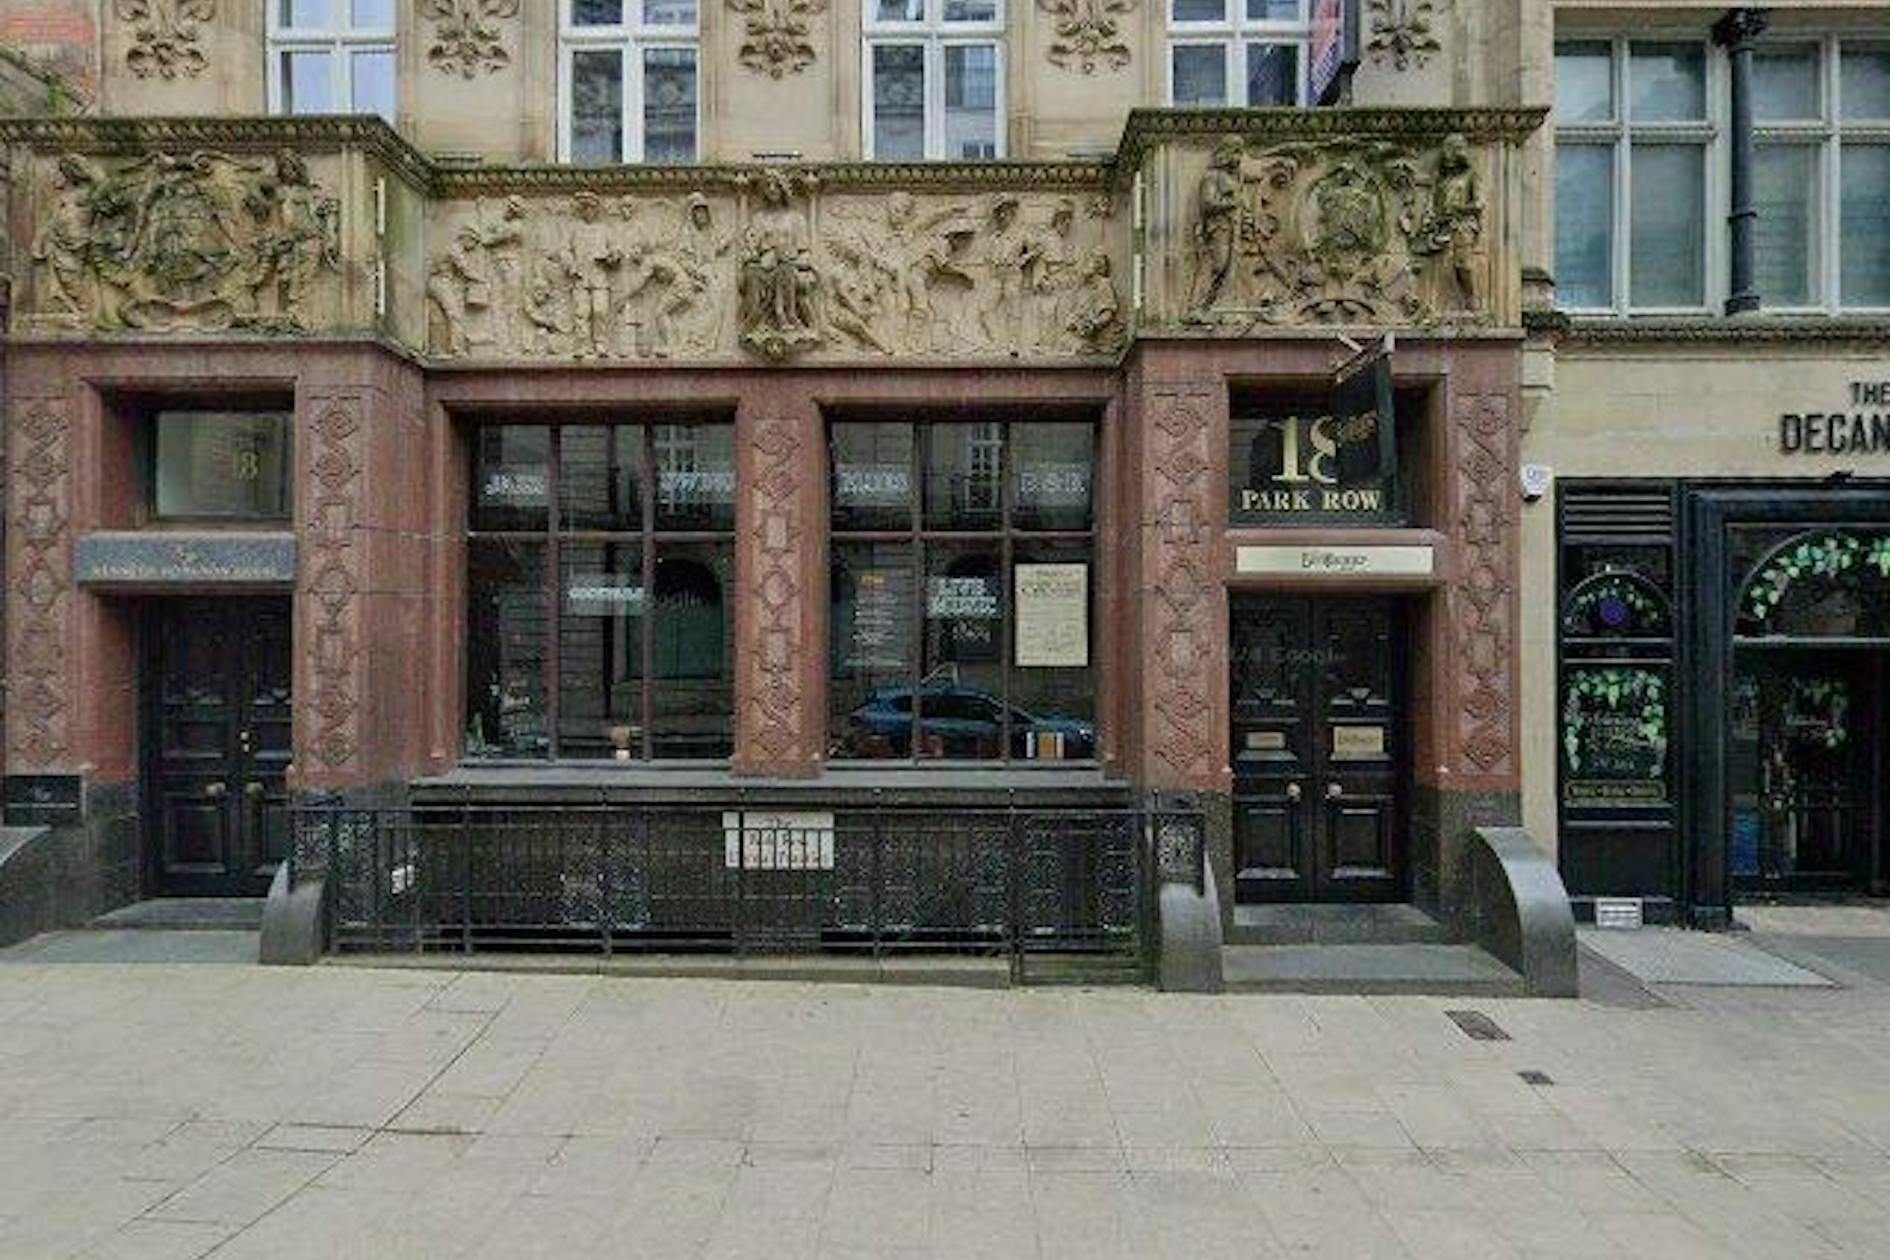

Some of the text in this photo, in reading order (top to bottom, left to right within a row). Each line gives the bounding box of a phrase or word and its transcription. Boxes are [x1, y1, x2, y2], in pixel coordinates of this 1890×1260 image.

[1849, 382, 1890, 405] THE
[1241, 489, 1383, 512] PARK ROW
